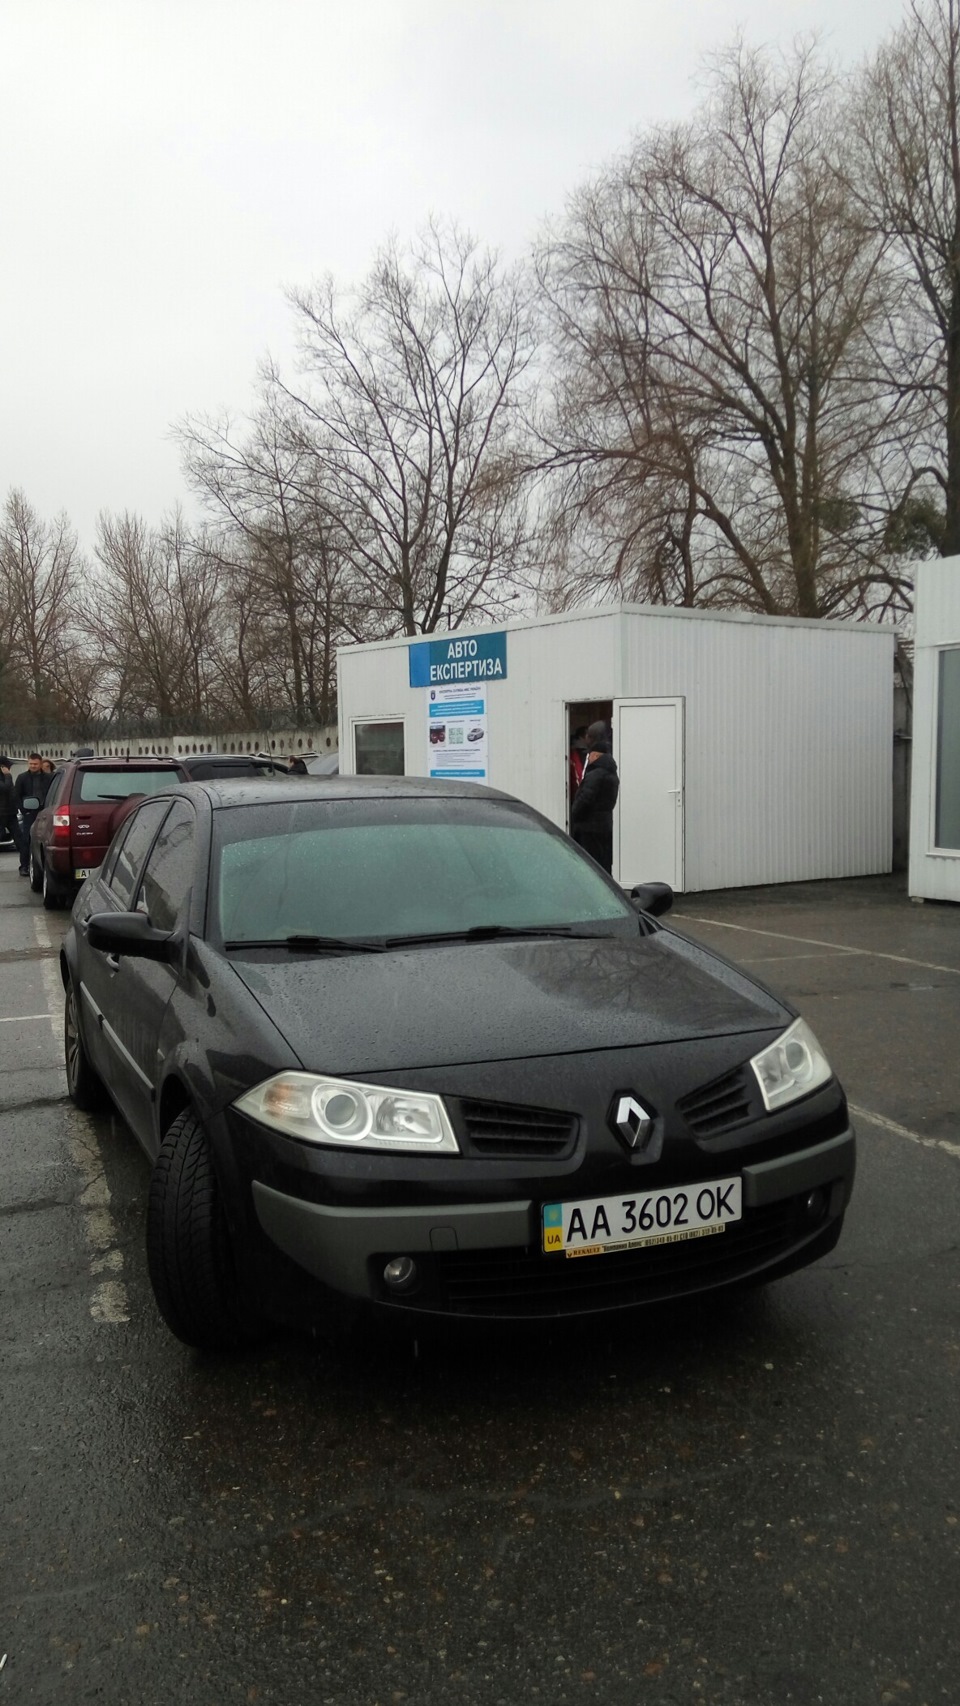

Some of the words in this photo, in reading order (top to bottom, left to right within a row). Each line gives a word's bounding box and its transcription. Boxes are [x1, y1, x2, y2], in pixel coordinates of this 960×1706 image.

[447, 639, 478, 659] АВТО
[430, 658, 503, 681] ЕКСПЕРТИЗА
[566, 1204, 611, 1242] AA
[621, 1193, 689, 1233] 3602
[696, 1183, 735, 1220] OK
[547, 1236, 561, 1245] UA
